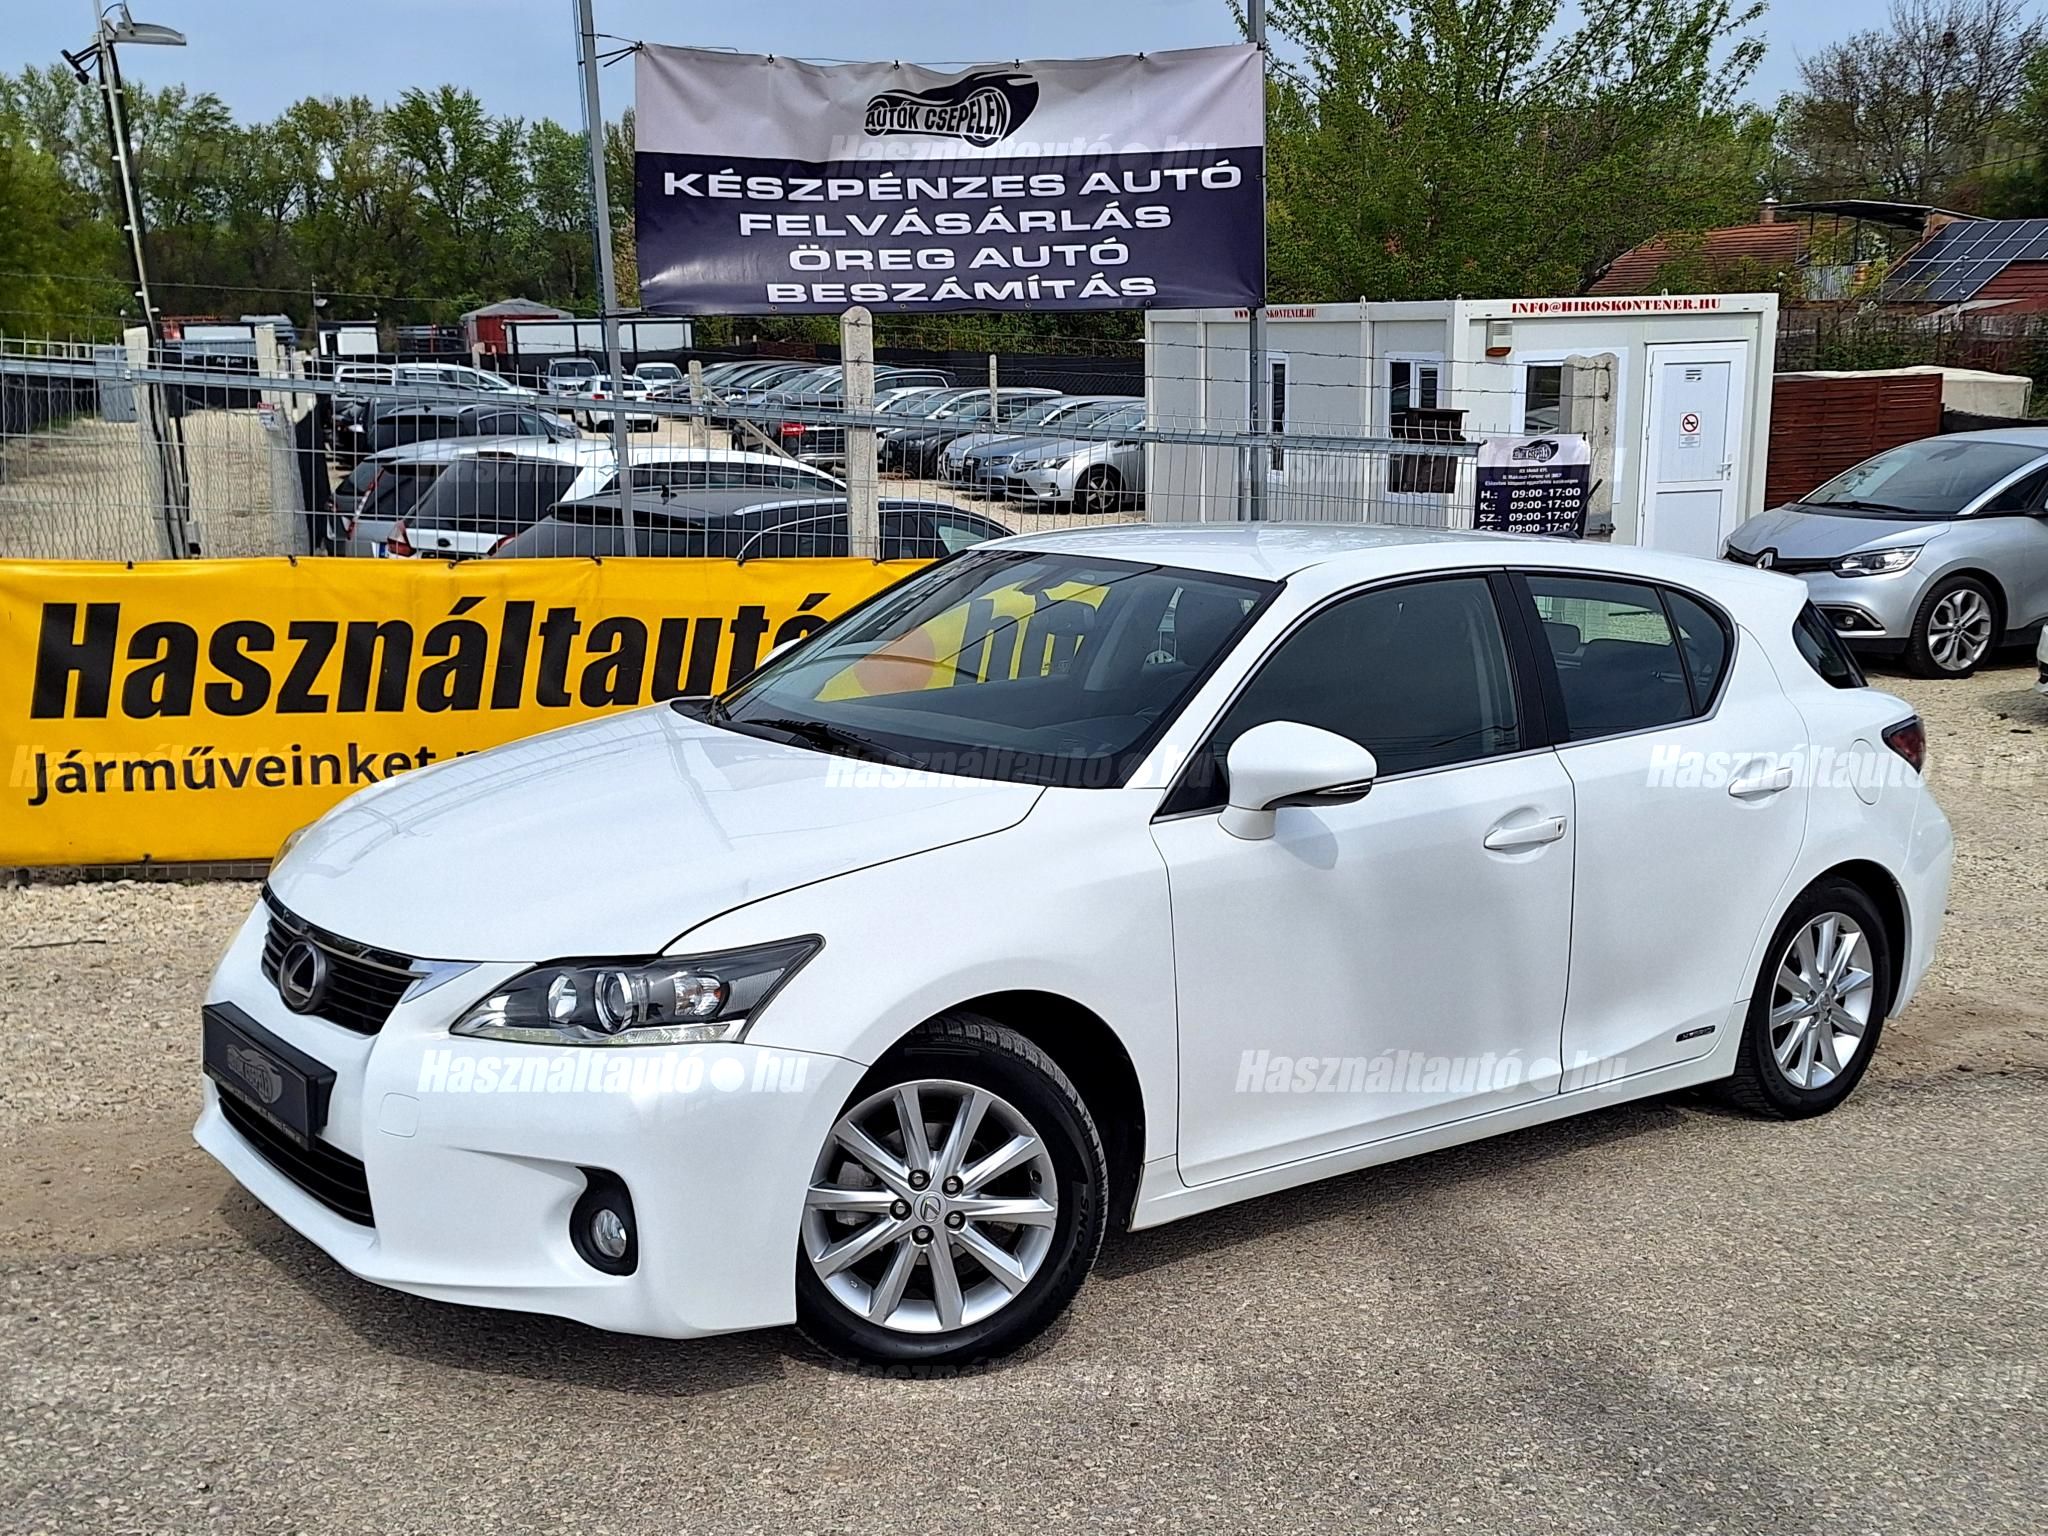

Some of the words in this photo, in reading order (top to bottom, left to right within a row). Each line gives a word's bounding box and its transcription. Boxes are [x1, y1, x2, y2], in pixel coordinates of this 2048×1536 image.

[924, 91, 1007, 136] CSEPELEN
[663, 167, 1067, 202] KÉSZPÉNZES
[1080, 159, 1242, 197] AUTÓ
[738, 201, 1172, 238] FELVÁSÁRLÁS
[789, 242, 955, 272] ÖREG
[968, 236, 1130, 268] AUTÓ
[766, 272, 1158, 304] BESZÁMÍTÁS
[1511, 298, 1722, 314] INFO@HIROSKONTENER.HU
[1510, 499, 1580, 510] 09:00-17:00
[1511, 488, 1581, 498] 09:00-17:00
[31, 593, 830, 719] Használtautó
[28, 742, 437, 806] Járműveinket
